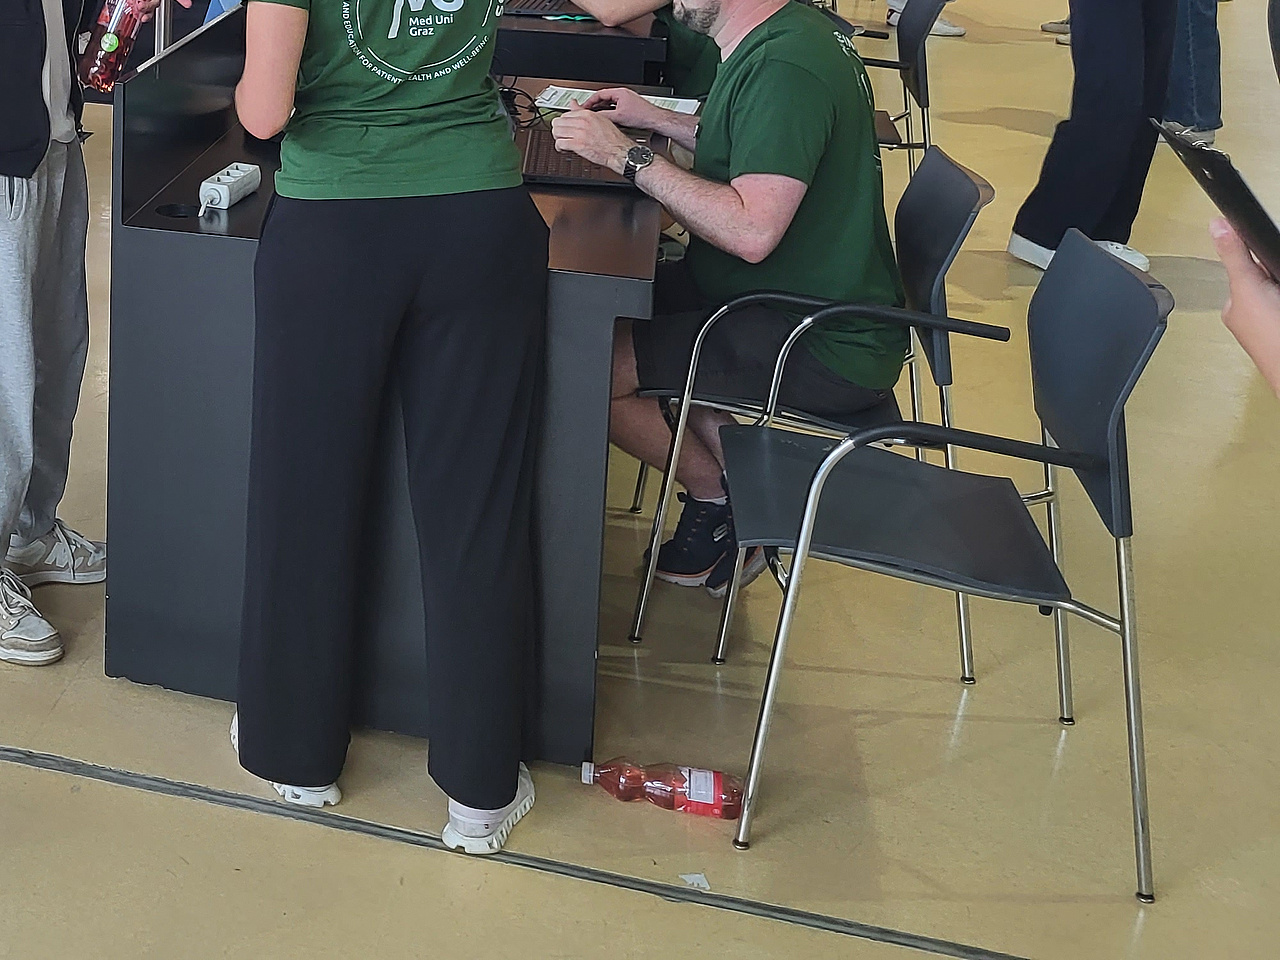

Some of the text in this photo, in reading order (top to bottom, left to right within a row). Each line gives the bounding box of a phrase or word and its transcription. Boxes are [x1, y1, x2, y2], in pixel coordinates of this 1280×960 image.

[342, 2, 350, 20] AND
[409, 14, 454, 27] Med Uni
[343, 20, 362, 56] EDUCATON
[409, 26, 435, 37] Graz
[358, 54, 374, 70] FOR
[406, 73, 432, 81] ALTH
[434, 67, 451, 78] AND
